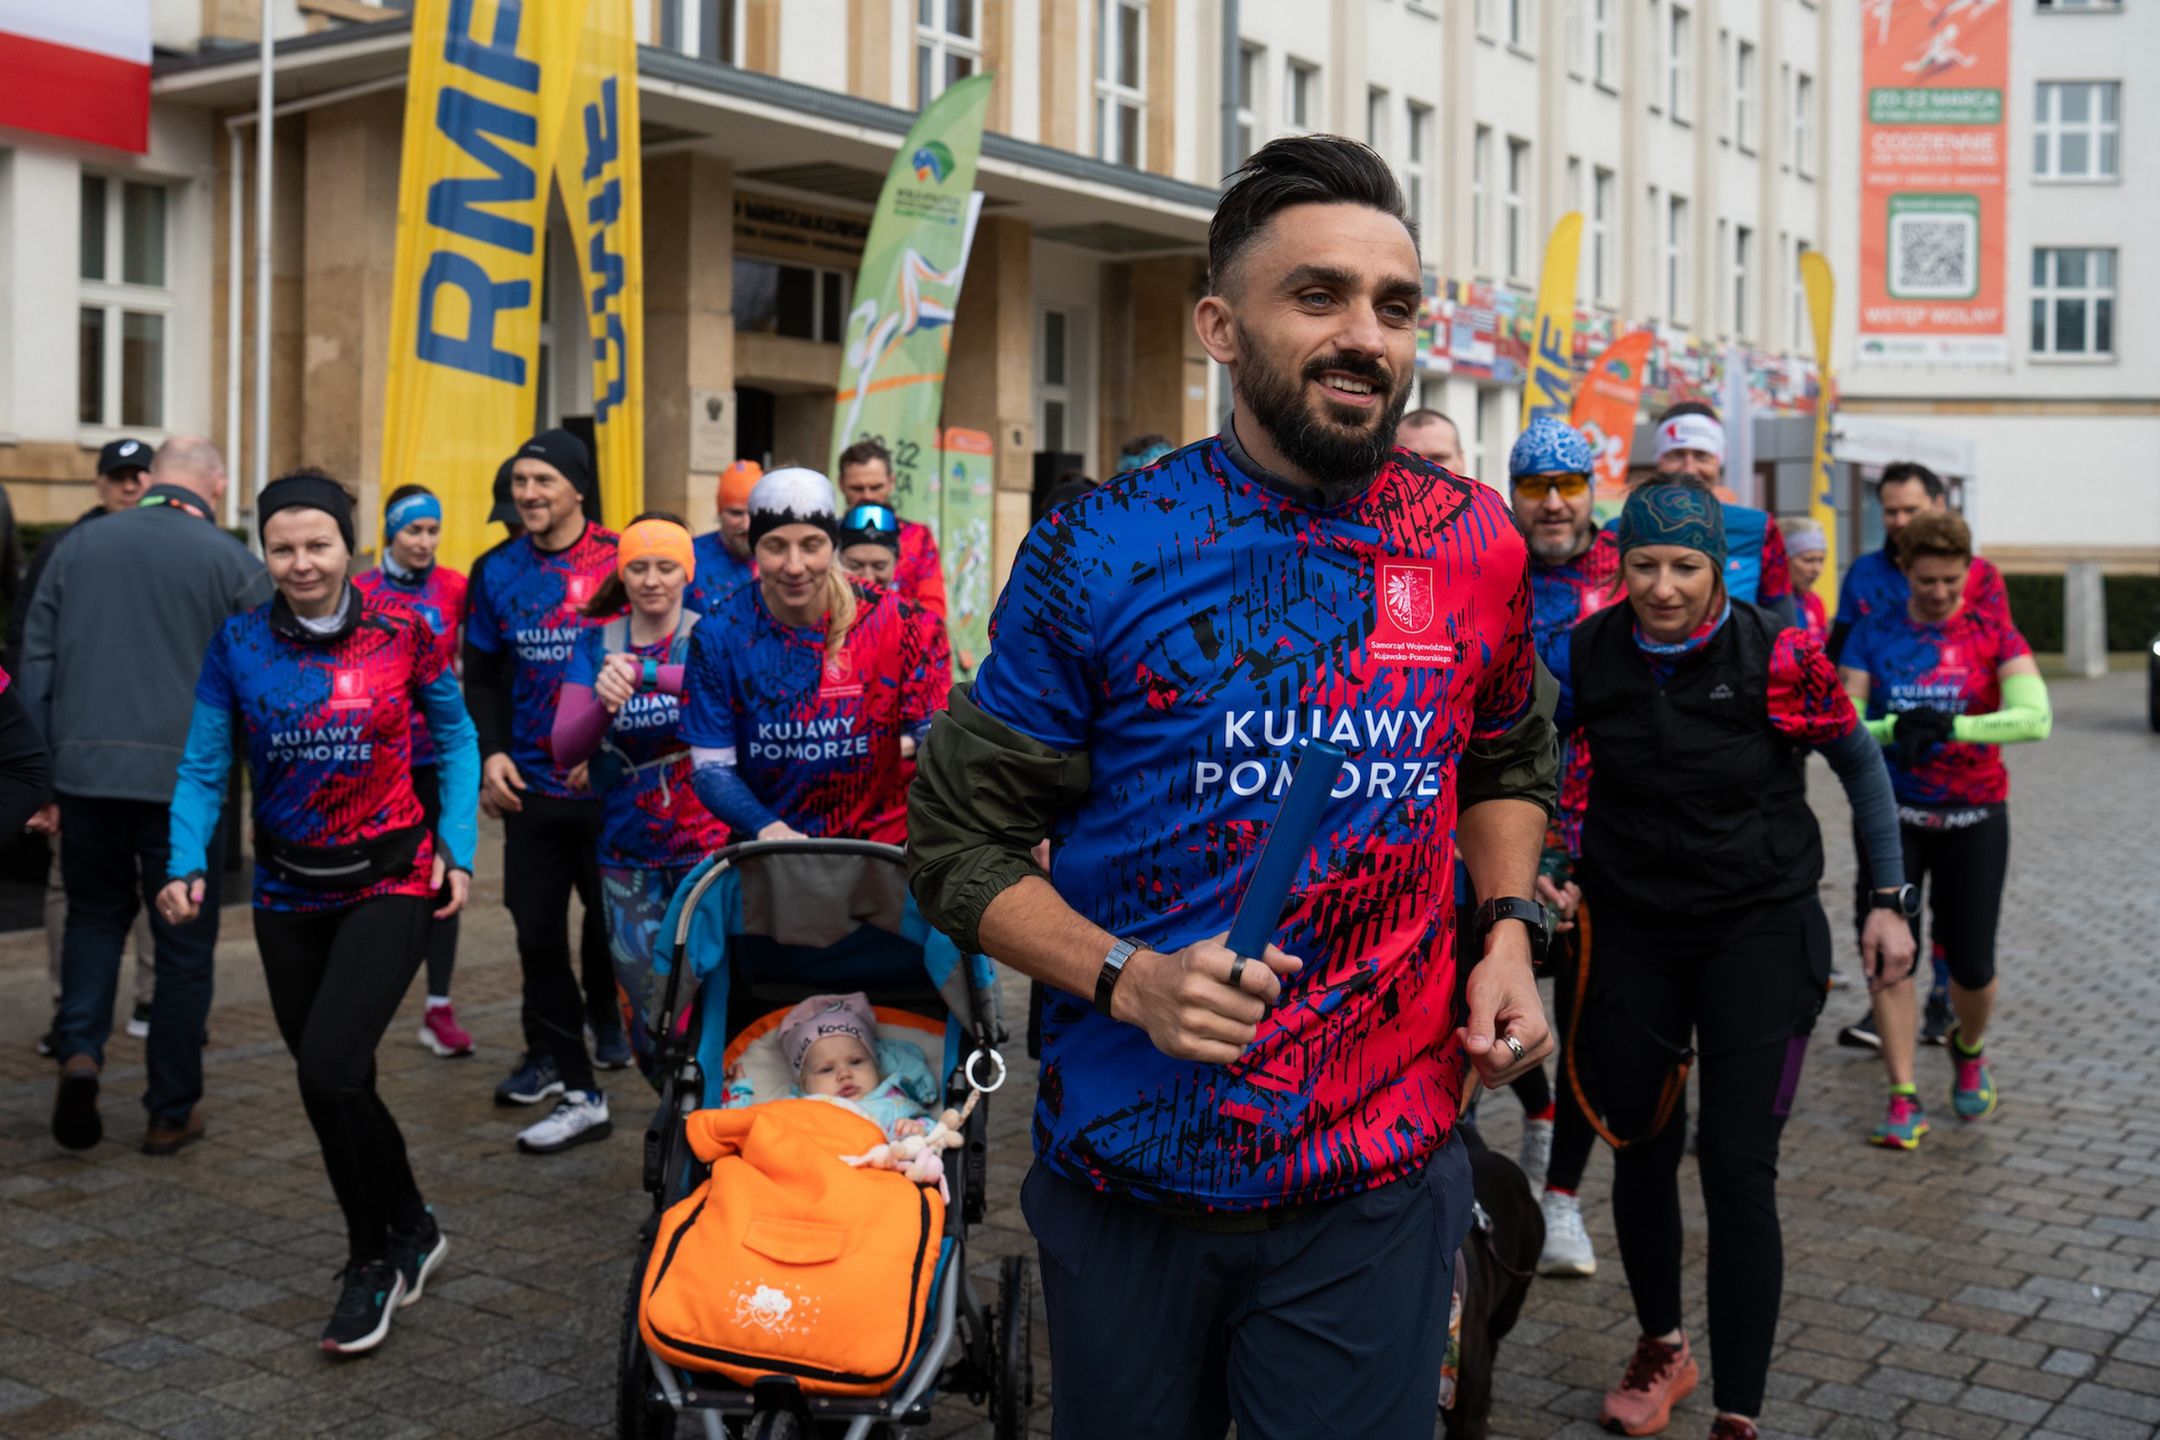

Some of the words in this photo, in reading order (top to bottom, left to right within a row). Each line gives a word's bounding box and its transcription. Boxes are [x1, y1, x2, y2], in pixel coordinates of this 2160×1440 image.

[416, 0, 540, 386] RMF
[1930, 306, 1998, 324] WOLNY
[1371, 641, 1405, 650] Samorząd
[1406, 642, 1452, 652] Województwa
[1890, 684, 1961, 698] KUJAWY
[271, 725, 363, 747] KUJAWY
[758, 716, 855, 740] KUJAWY
[1225, 709, 1434, 748] KUJAWY
[266, 743, 372, 762] POMORZE
[749, 735, 868, 760] POMORZE
